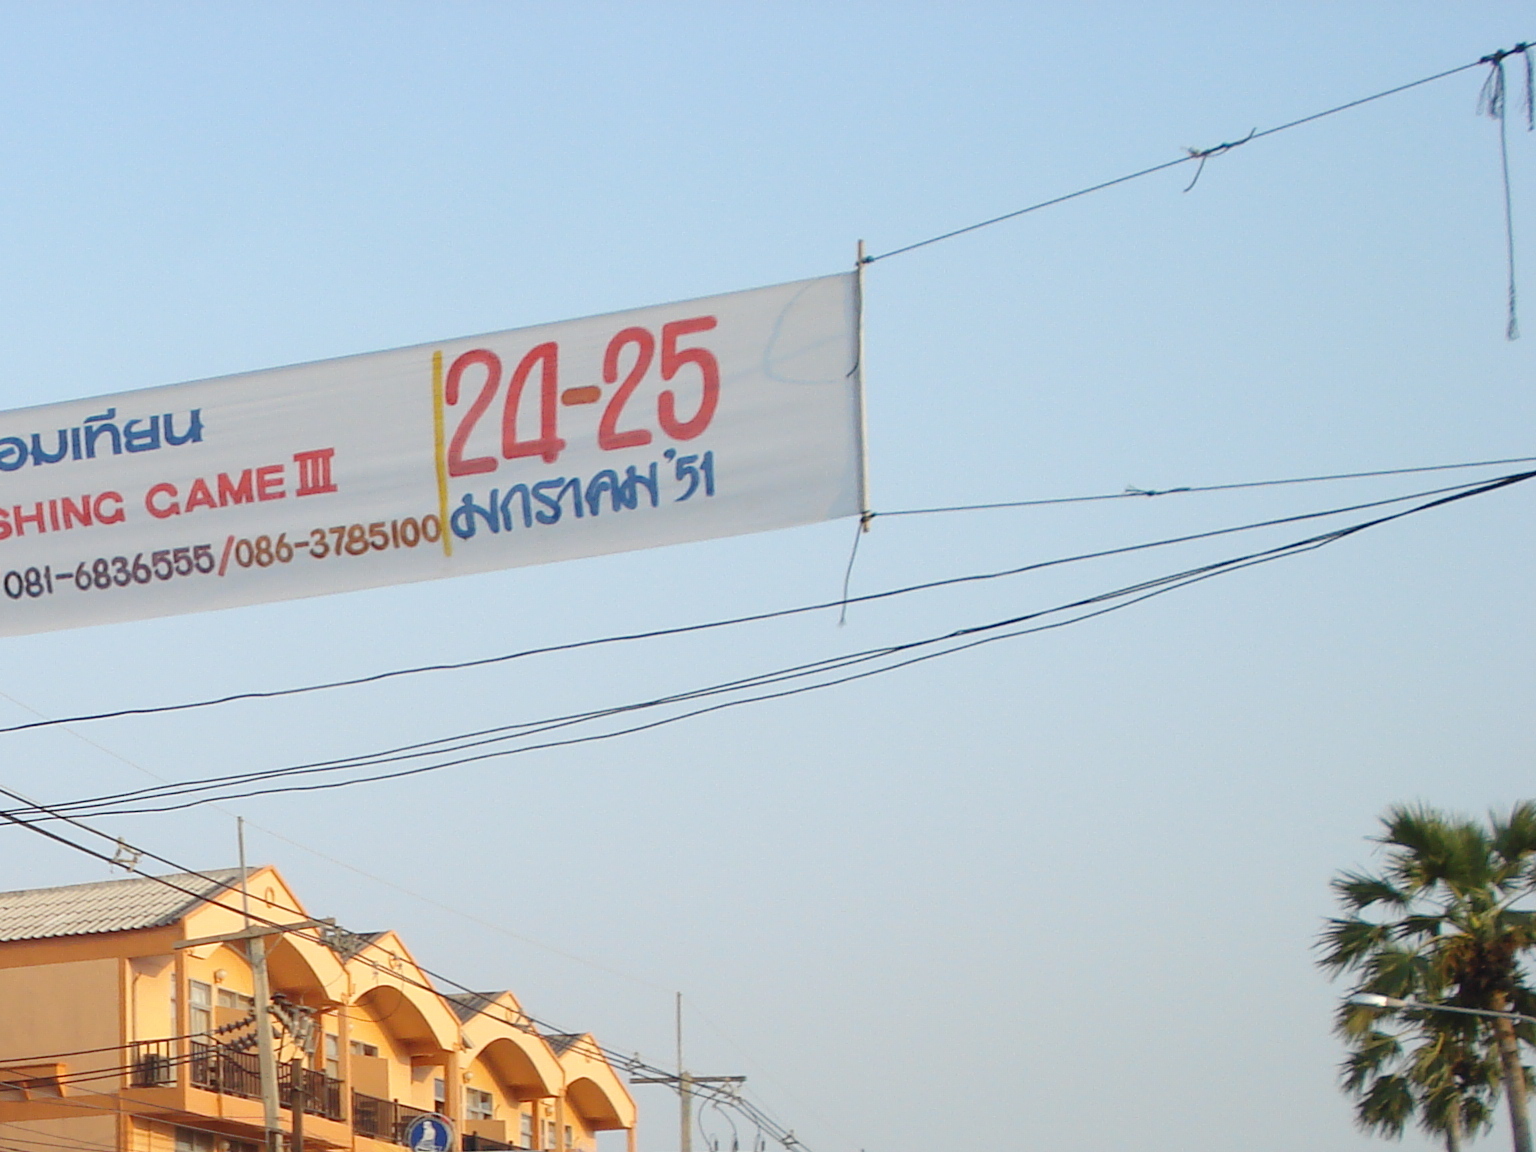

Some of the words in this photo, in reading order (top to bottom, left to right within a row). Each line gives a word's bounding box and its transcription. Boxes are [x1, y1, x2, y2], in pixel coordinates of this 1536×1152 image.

[445, 315, 720, 478] 24-25
[145, 464, 286, 519] GAME
[451, 462, 659, 539] มกราคม
